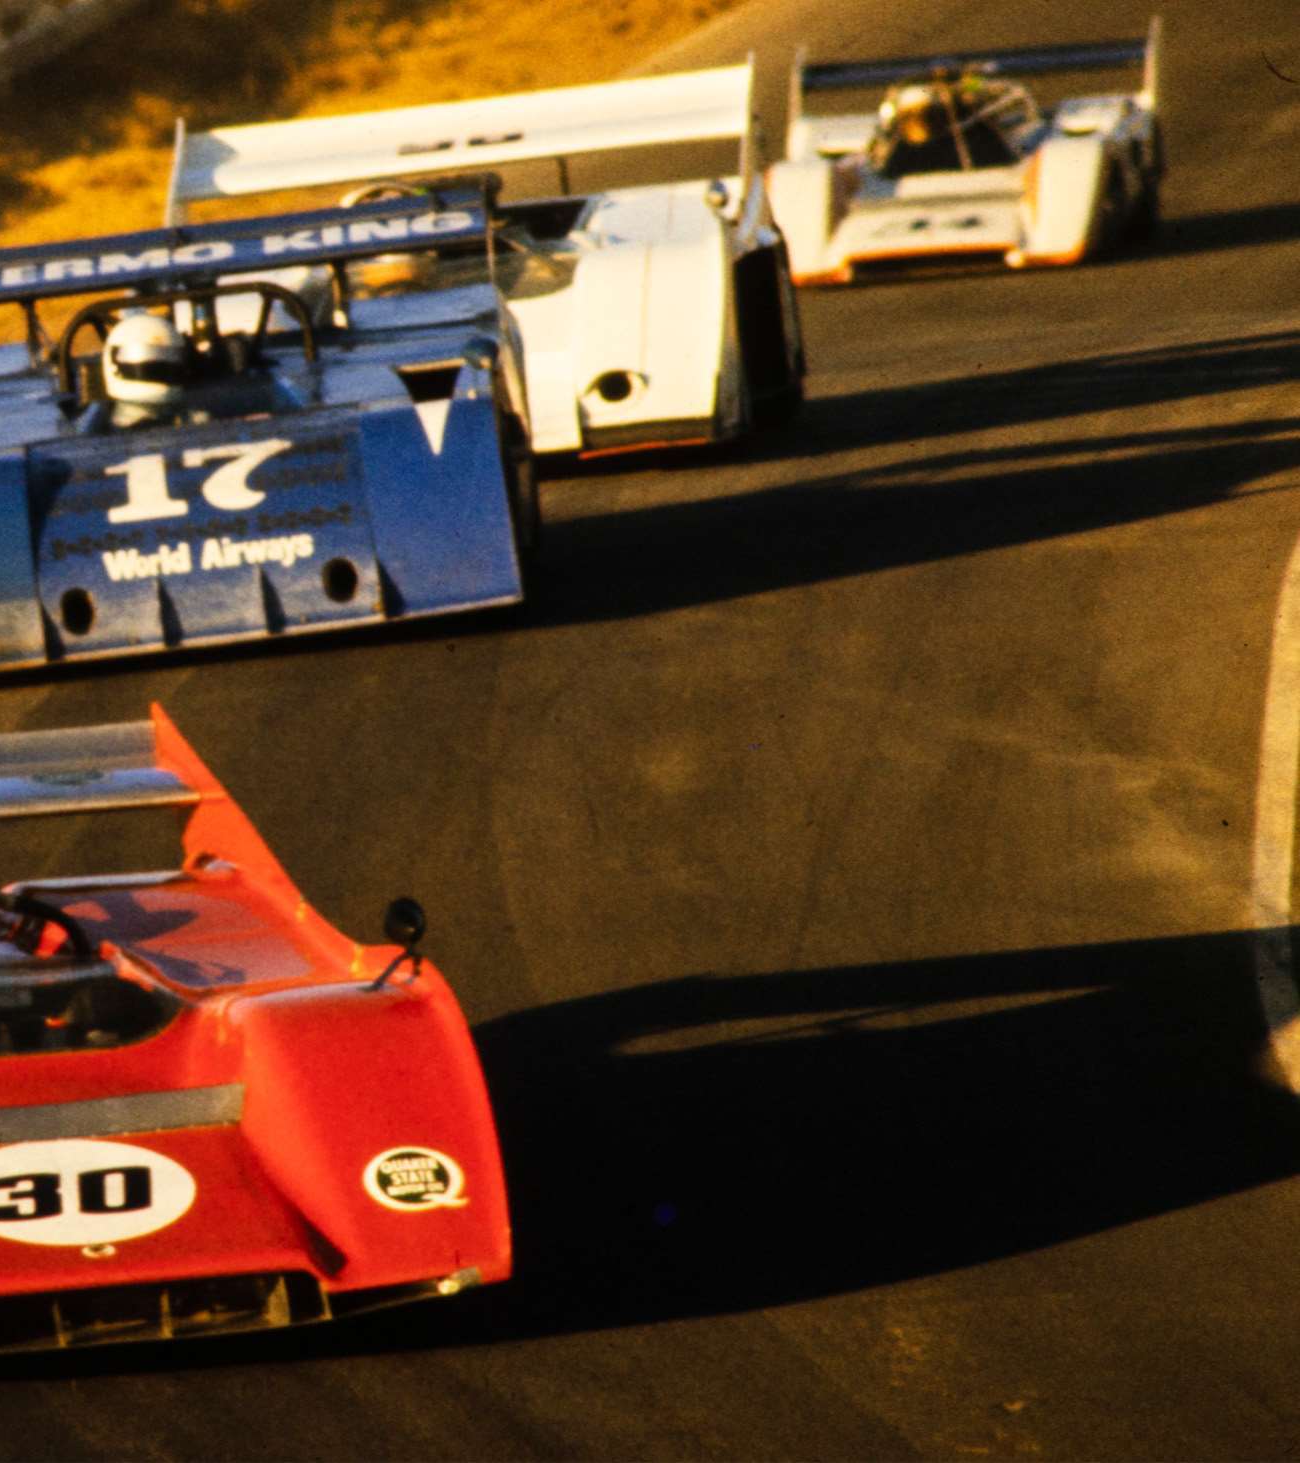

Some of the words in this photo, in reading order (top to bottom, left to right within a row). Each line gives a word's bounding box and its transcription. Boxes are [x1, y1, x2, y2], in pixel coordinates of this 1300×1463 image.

[263, 211, 473, 254] KING
[104, 438, 293, 524] 17
[102, 542, 192, 582] World
[201, 533, 315, 570] Airways
[390, 1169, 436, 1186] STATE
